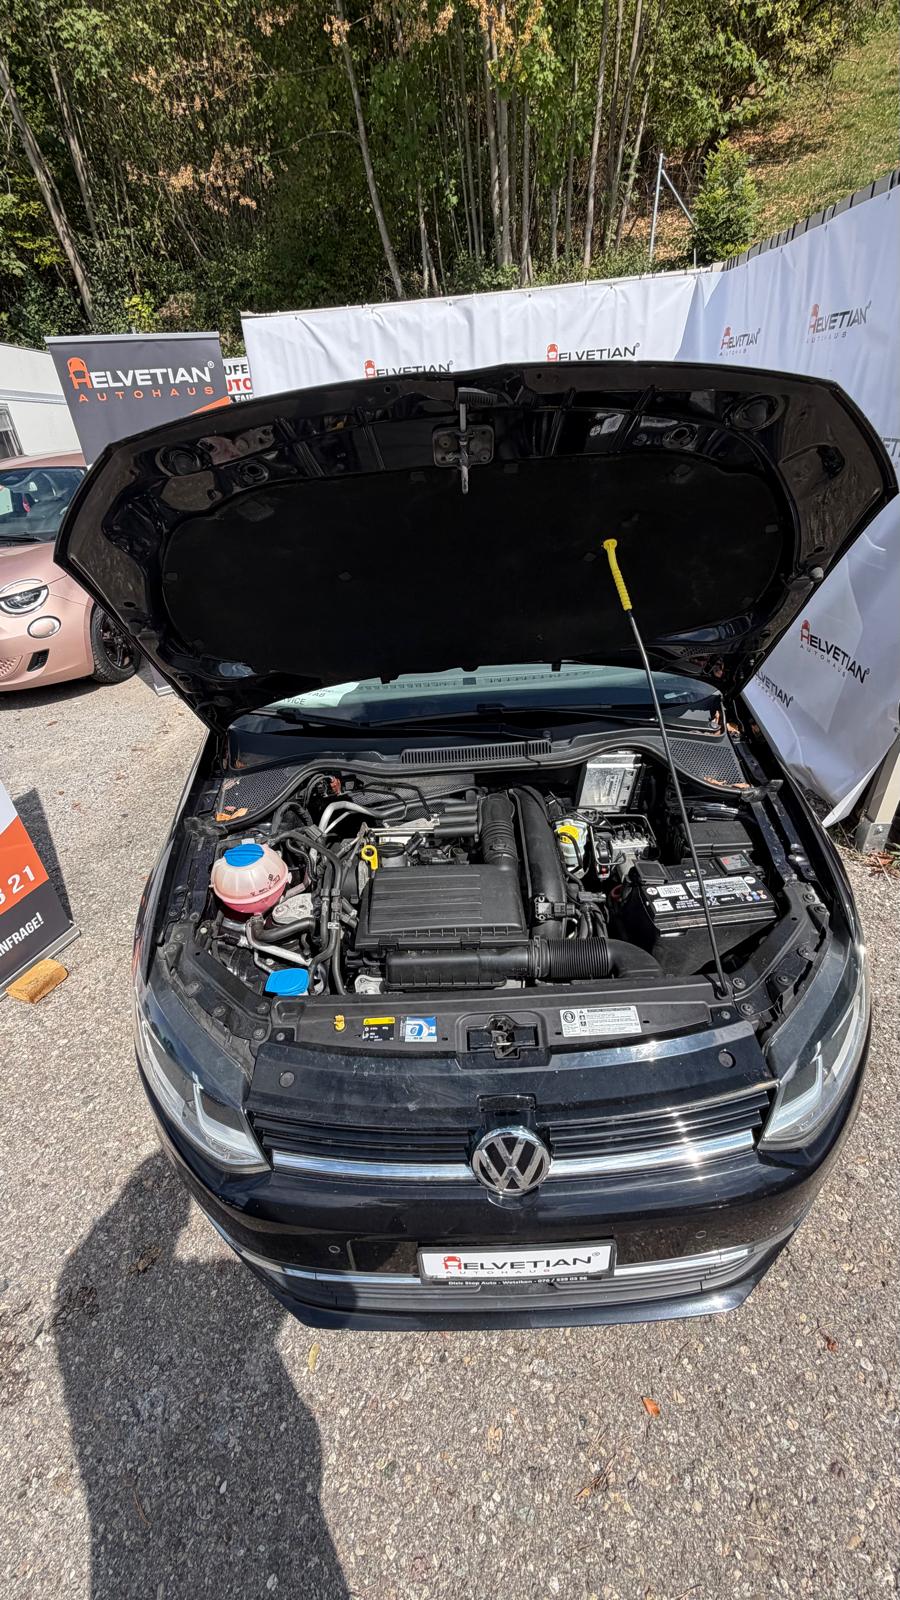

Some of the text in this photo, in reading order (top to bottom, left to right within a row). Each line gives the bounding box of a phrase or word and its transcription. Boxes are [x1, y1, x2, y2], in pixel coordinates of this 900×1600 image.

[66, 357, 213, 390] HELVETIAN
[79, 386, 215, 403] AUTOHAUS
[800, 620, 868, 683] HELVETIAN
[8, 865, 35, 894] 21
[443, 1256, 592, 1271] HELVETIAN
